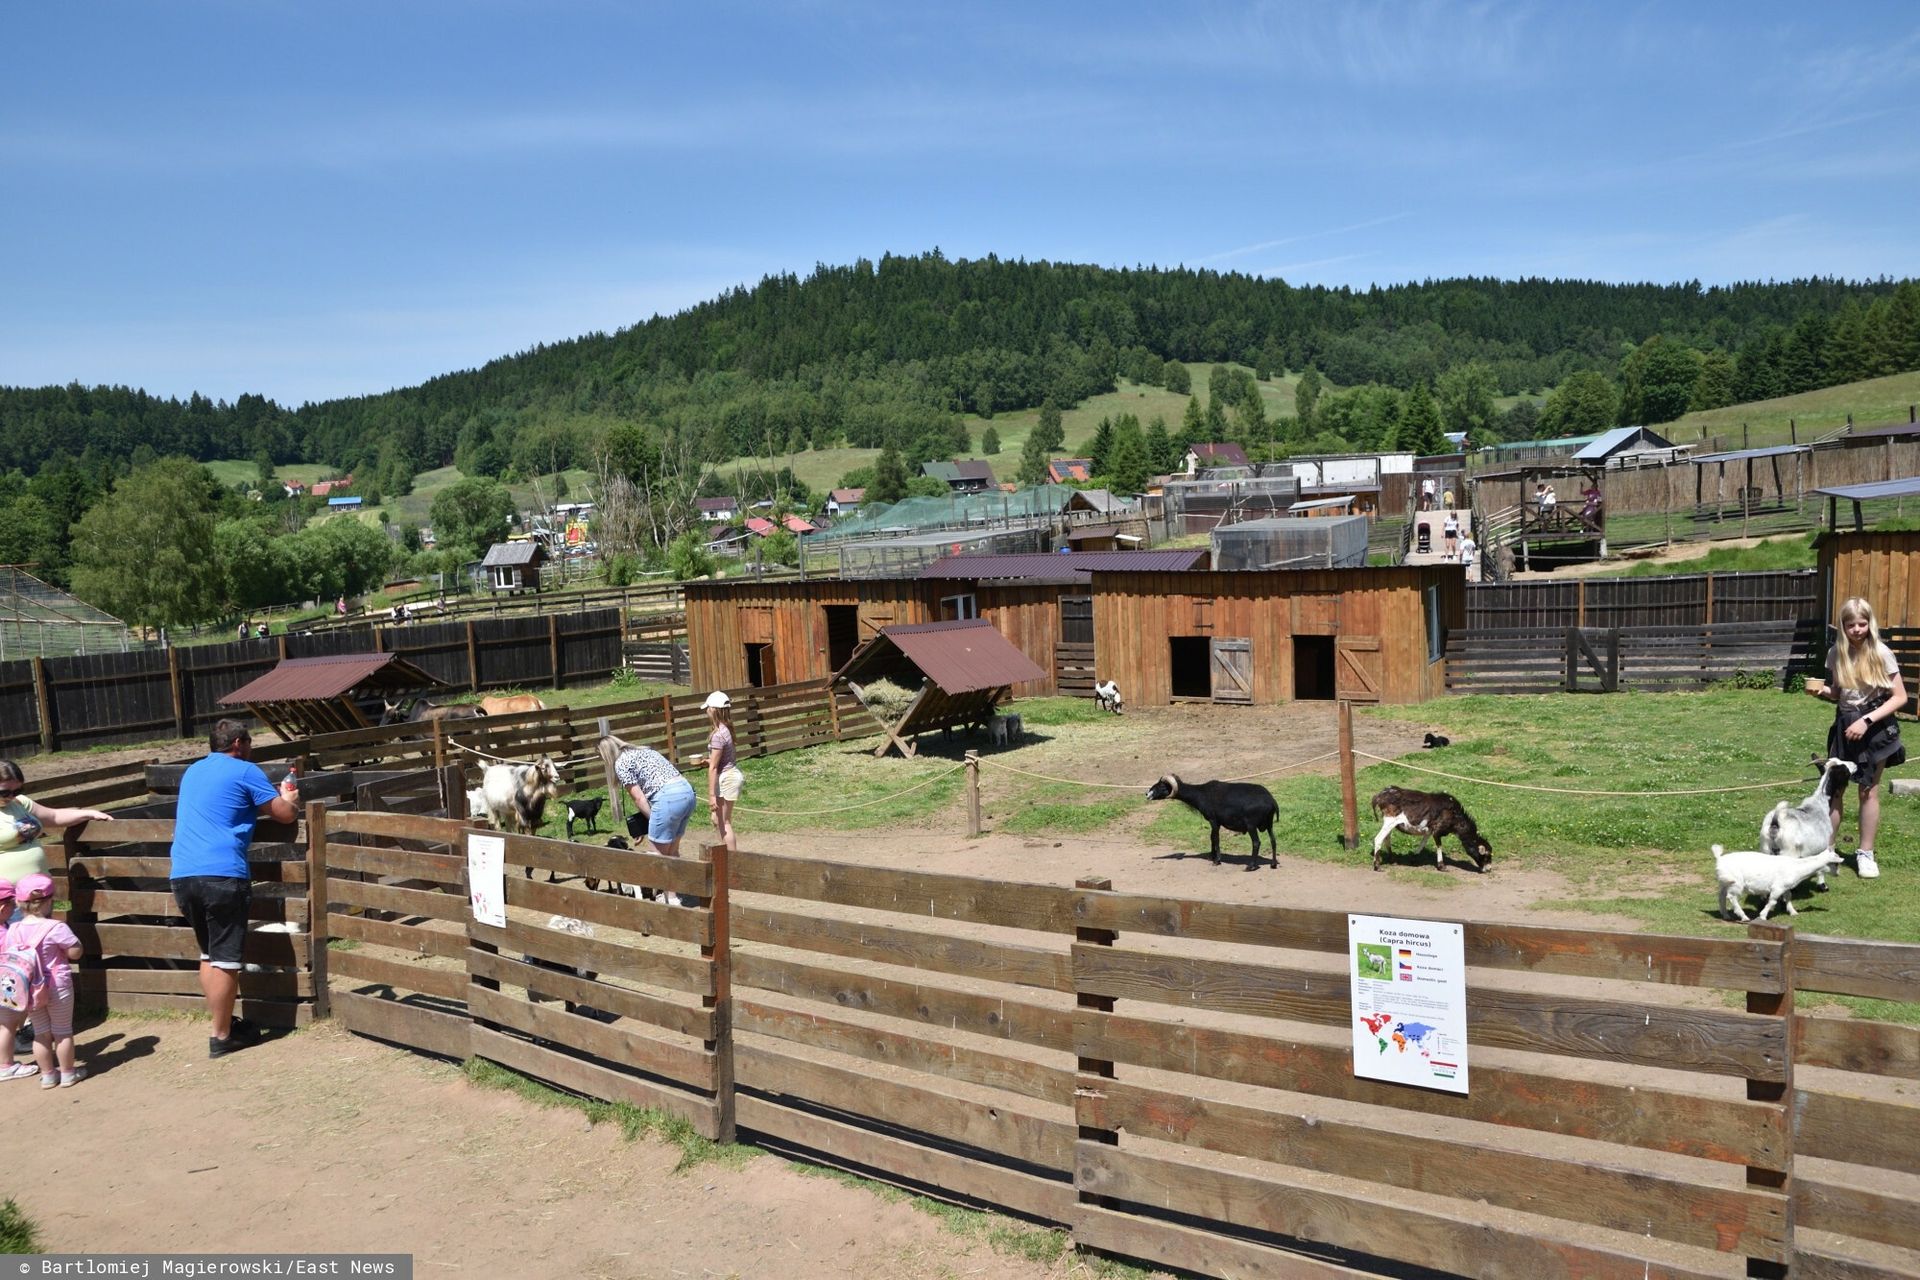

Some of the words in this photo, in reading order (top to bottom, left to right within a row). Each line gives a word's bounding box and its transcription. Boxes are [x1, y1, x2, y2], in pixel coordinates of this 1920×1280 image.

[1398, 931, 1430, 939] domowa
[1379, 936, 1404, 945] (Capra
[1405, 939, 1431, 948] hircus)
